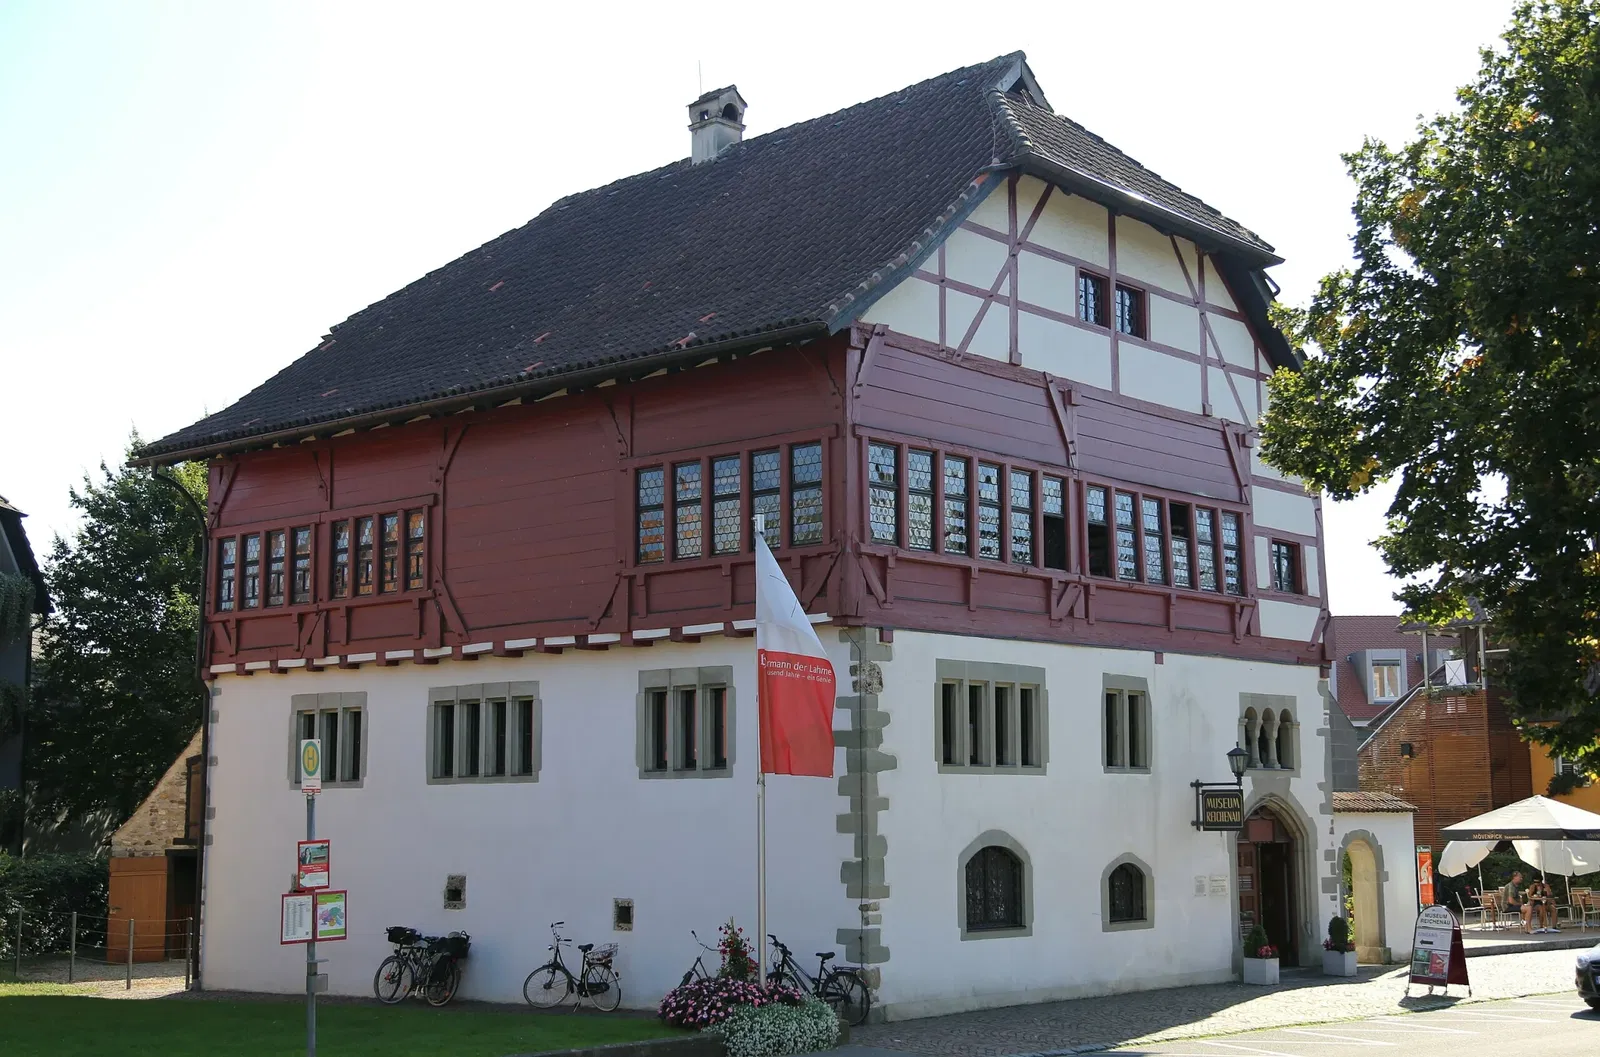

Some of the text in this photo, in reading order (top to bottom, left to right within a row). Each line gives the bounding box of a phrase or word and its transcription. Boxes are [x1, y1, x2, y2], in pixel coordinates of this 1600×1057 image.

[794, 661, 808, 671] der
[809, 665, 832, 675] Lahme
[785, 671, 800, 679] Jahre
[815, 675, 832, 684] Genie
[1206, 797, 1240, 808] MUSEUM
[1206, 811, 1241, 822] REICHENAU
[1420, 918, 1451, 926] REICHENAU
